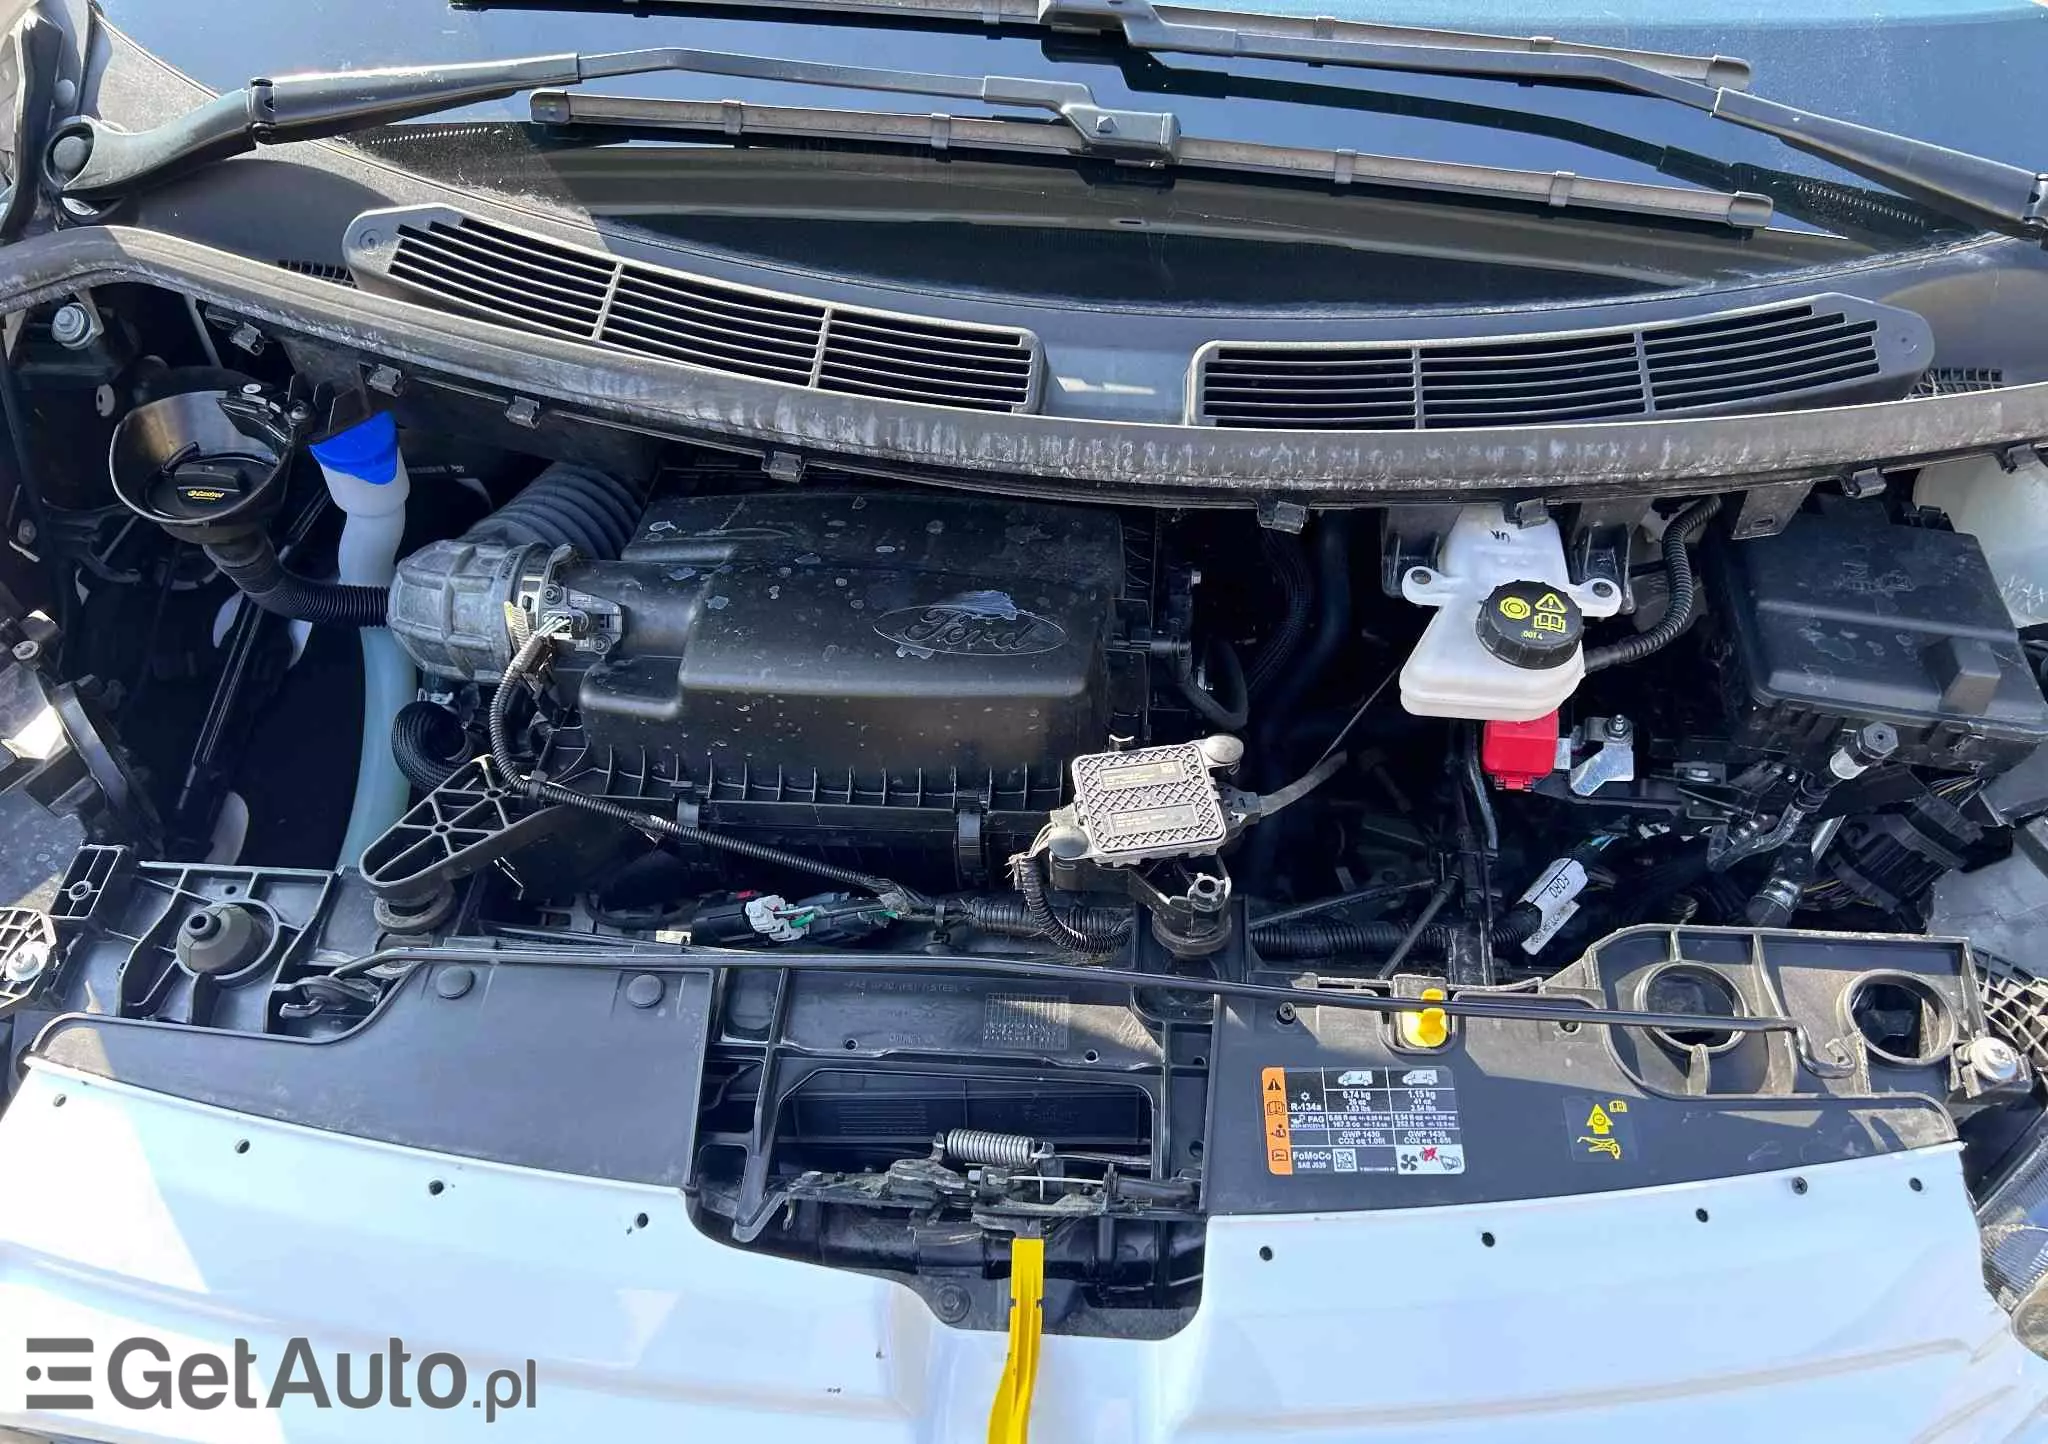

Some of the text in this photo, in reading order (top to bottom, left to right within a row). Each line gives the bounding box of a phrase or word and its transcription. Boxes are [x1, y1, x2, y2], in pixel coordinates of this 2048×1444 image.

[1360, 1090, 1371, 1101] kg
[1426, 1089, 1436, 1101] kg
[1290, 1102, 1322, 1111] R-134a
[1342, 1130, 1361, 1138] GWP
[1338, 1137, 1355, 1145] CO2
[1403, 1136, 1420, 1144] CO2
[1292, 1151, 1332, 1160] FoMoCo
